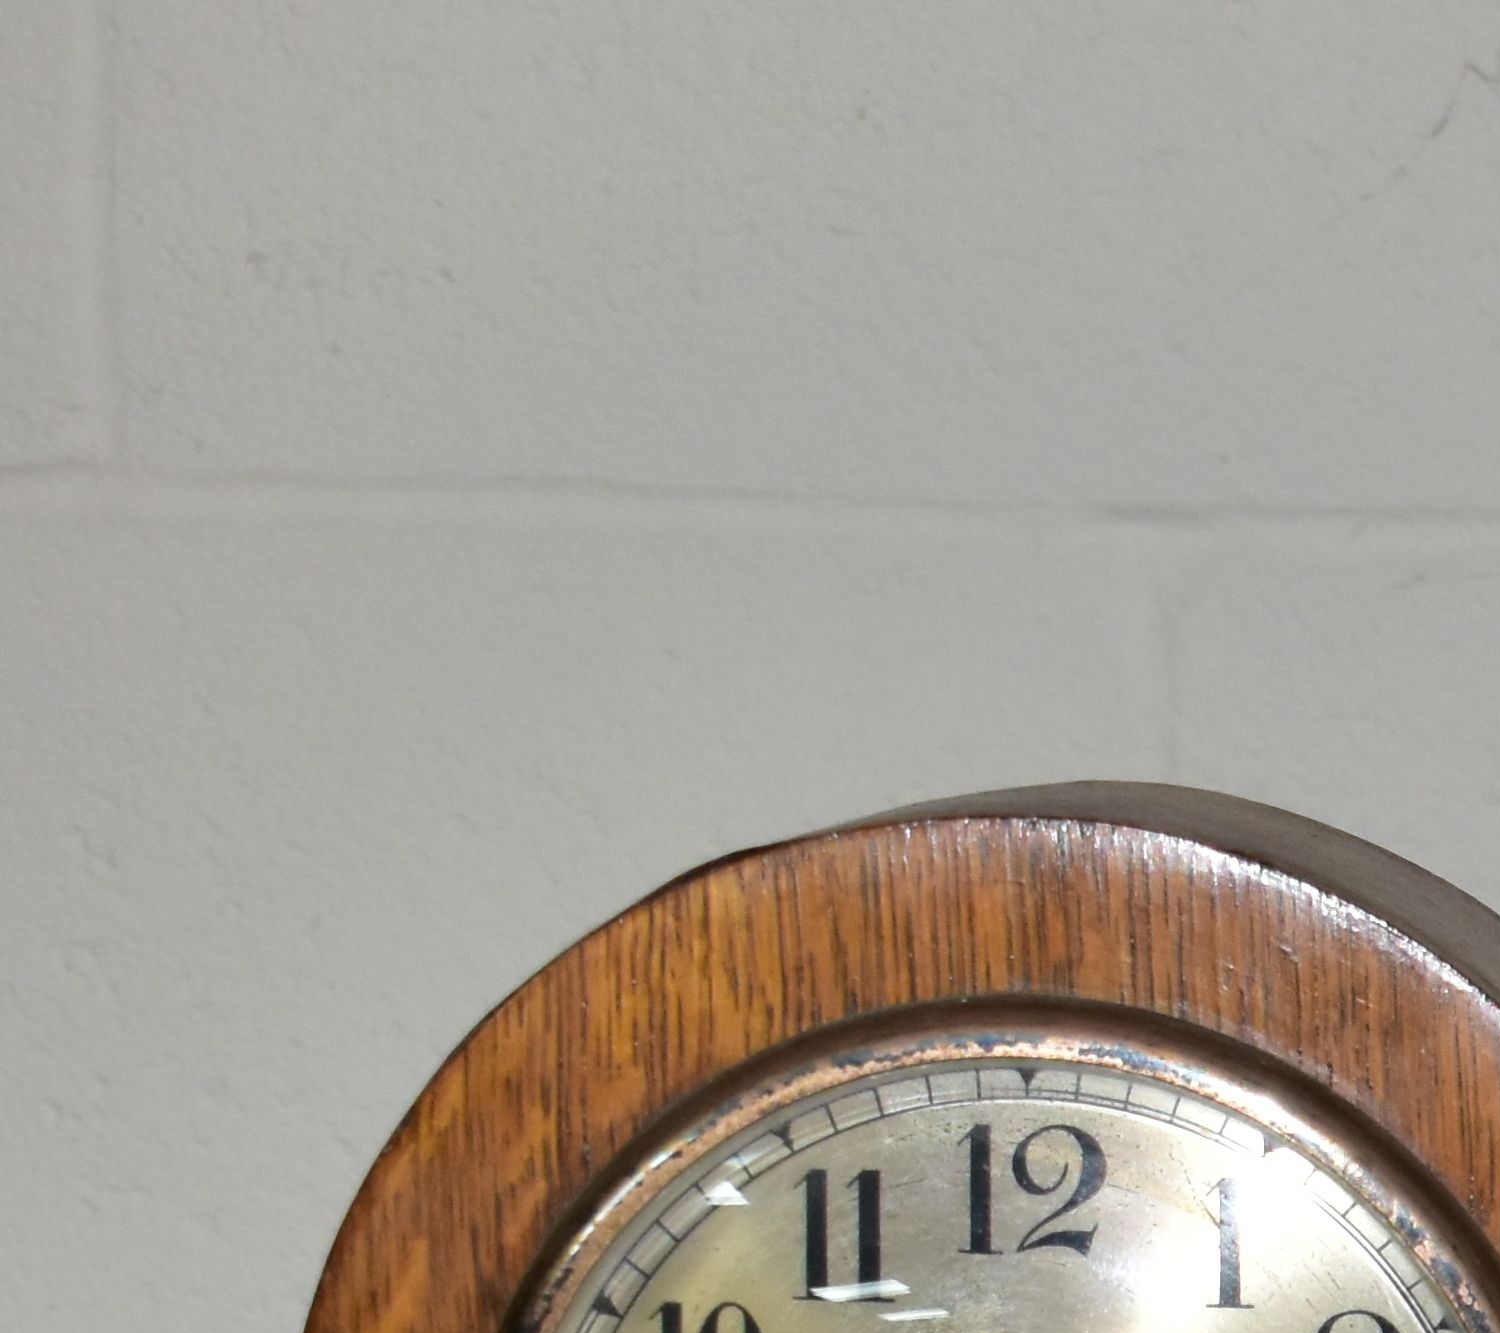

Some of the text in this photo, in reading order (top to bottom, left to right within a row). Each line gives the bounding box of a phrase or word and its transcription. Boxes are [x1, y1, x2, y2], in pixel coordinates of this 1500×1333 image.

[793, 1167, 898, 1304] 11
[957, 1122, 1108, 1256] 12
[1205, 1176, 1256, 1309] 1
